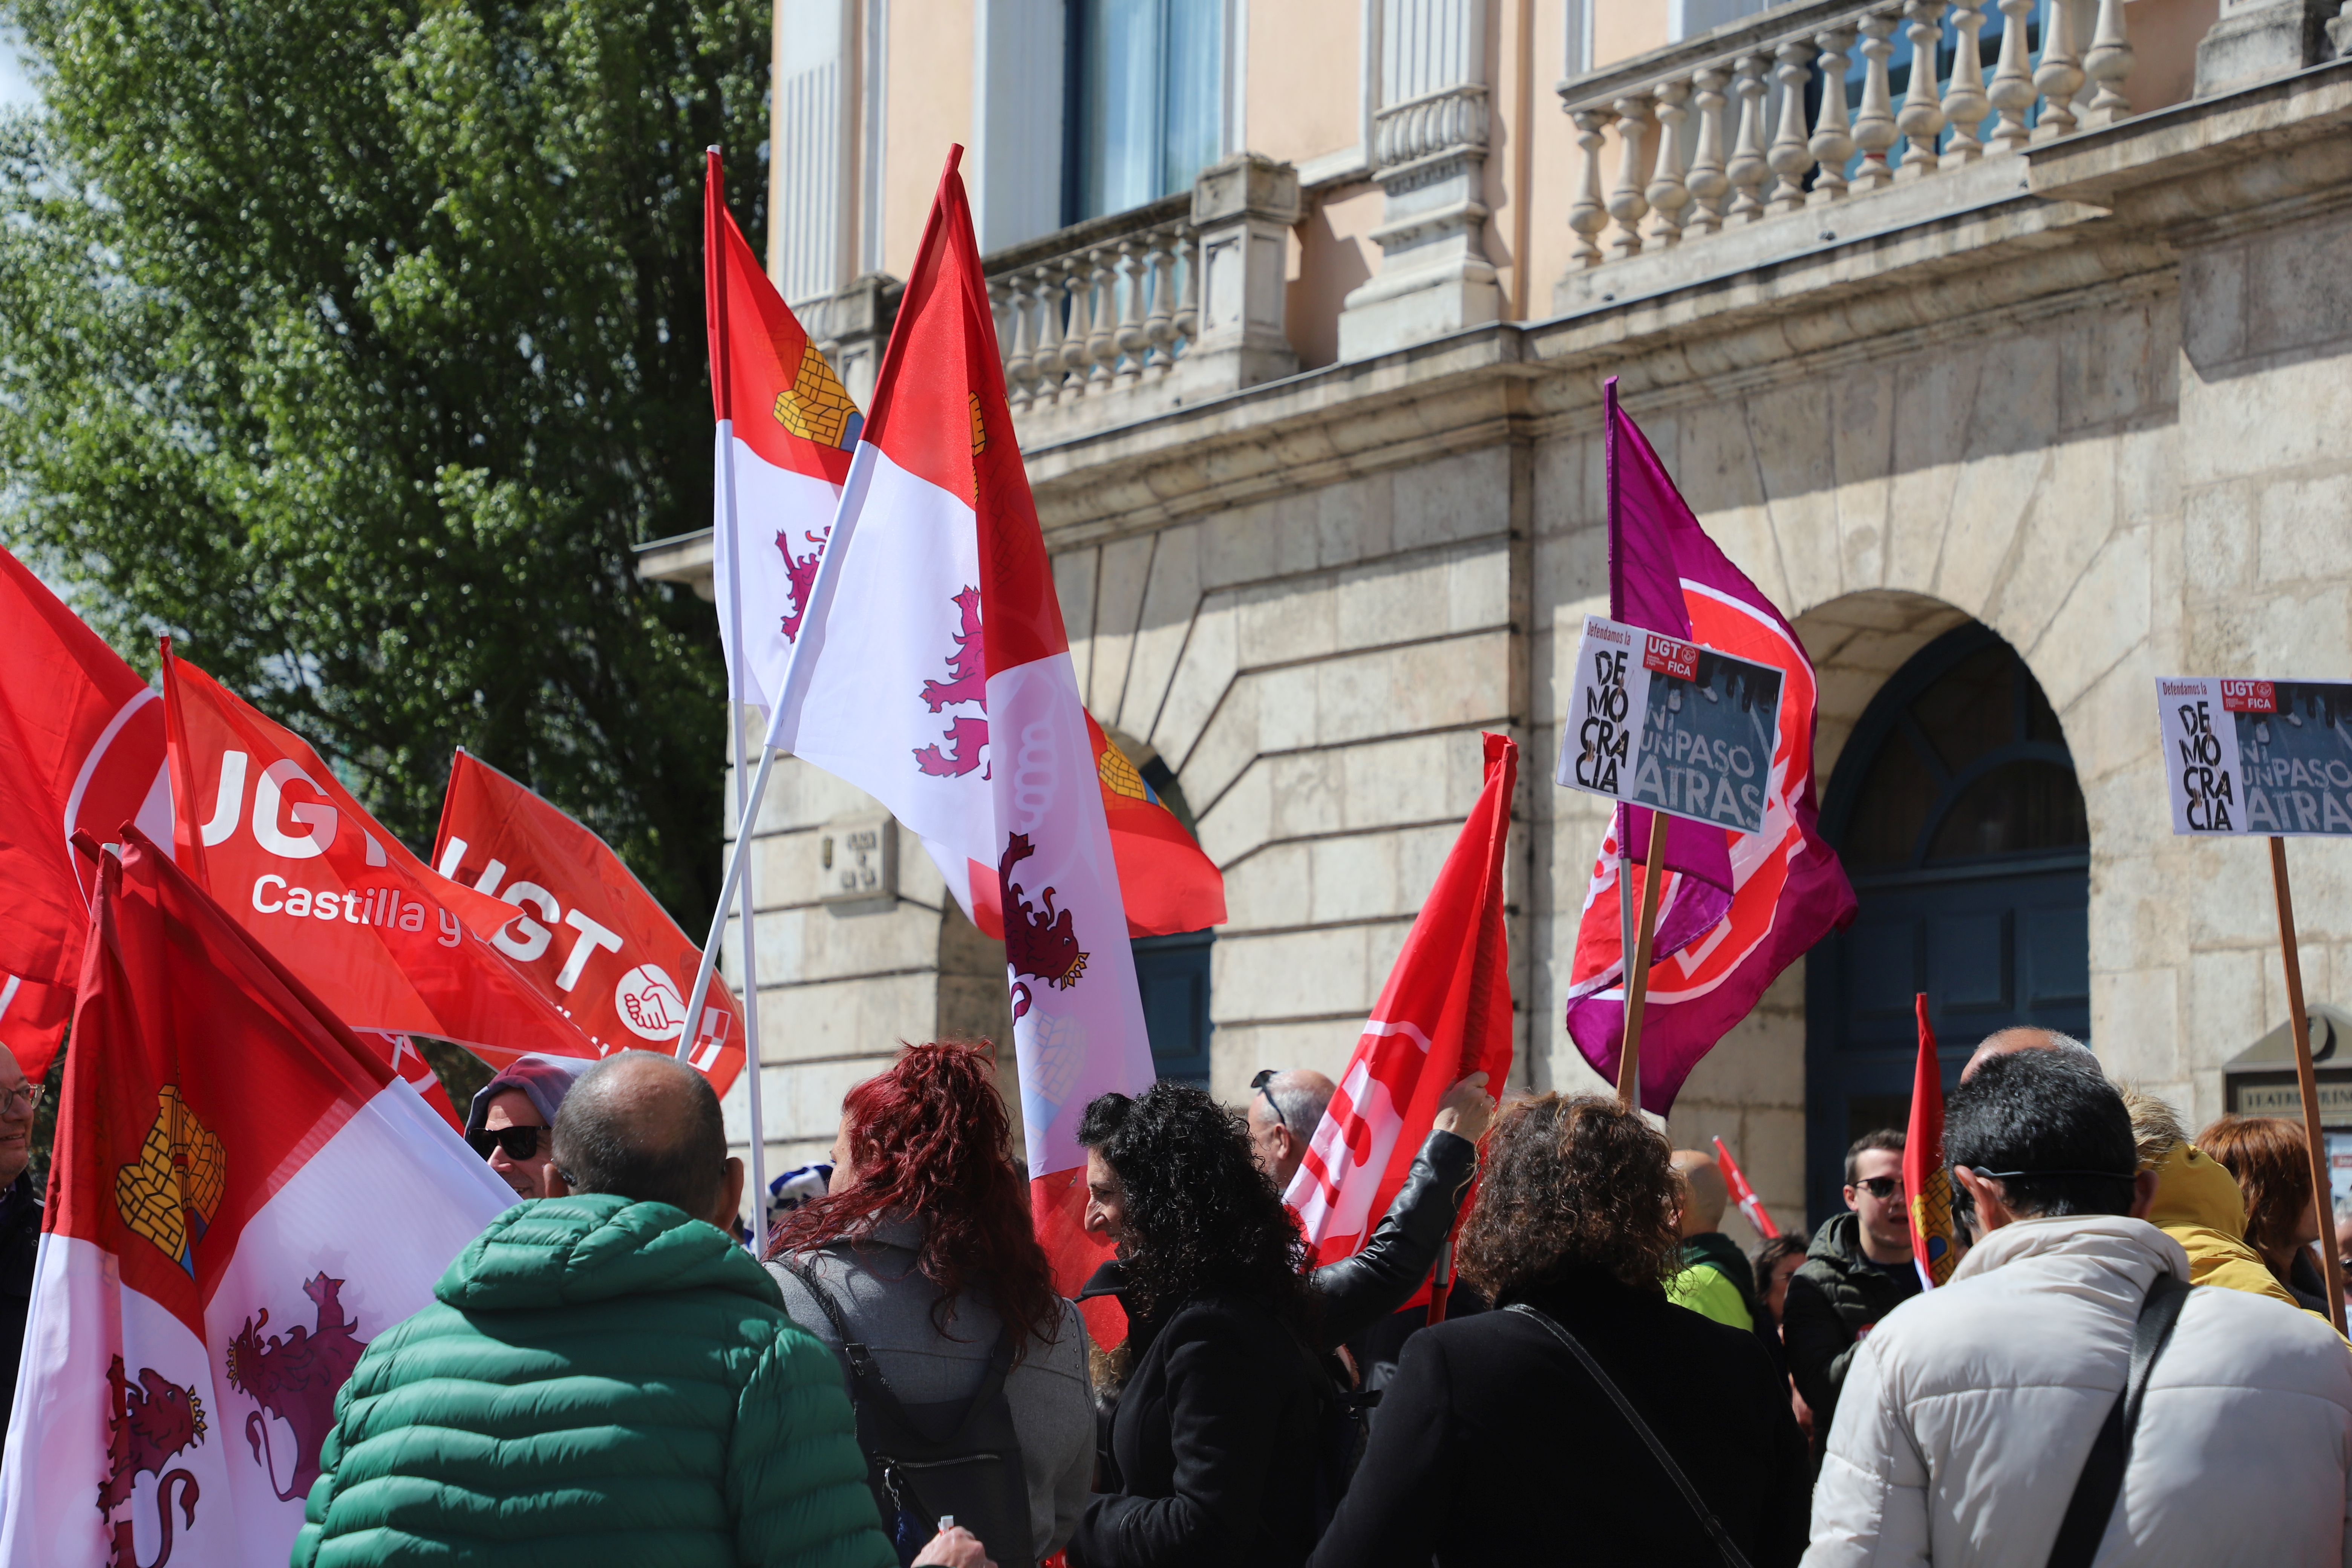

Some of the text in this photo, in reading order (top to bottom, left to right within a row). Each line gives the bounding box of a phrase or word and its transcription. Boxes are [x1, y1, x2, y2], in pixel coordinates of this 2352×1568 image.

[1587, 621, 1631, 646] Defendamos la
[1648, 635, 1681, 659] UGT
[1595, 650, 1628, 686] DE
[1667, 660, 1691, 677] FICA
[1587, 685, 1629, 723] MO
[2163, 681, 2207, 696] Defendamos la
[2224, 681, 2255, 697] UGT
[2248, 698, 2271, 709] FICA
[2178, 701, 2210, 737] DE
[1580, 716, 1630, 769] CRA
[1640, 729, 1755, 778] UN PASO
[2179, 734, 2222, 768] MO
[1576, 751, 1619, 794] CIA
[2184, 766, 2234, 806] CRA
[2241, 757, 2352, 788] UN PASO
[2186, 798, 2233, 831] CIA
[2246, 786, 2352, 831] ATRÁ
[252, 874, 461, 948] Castilla y
